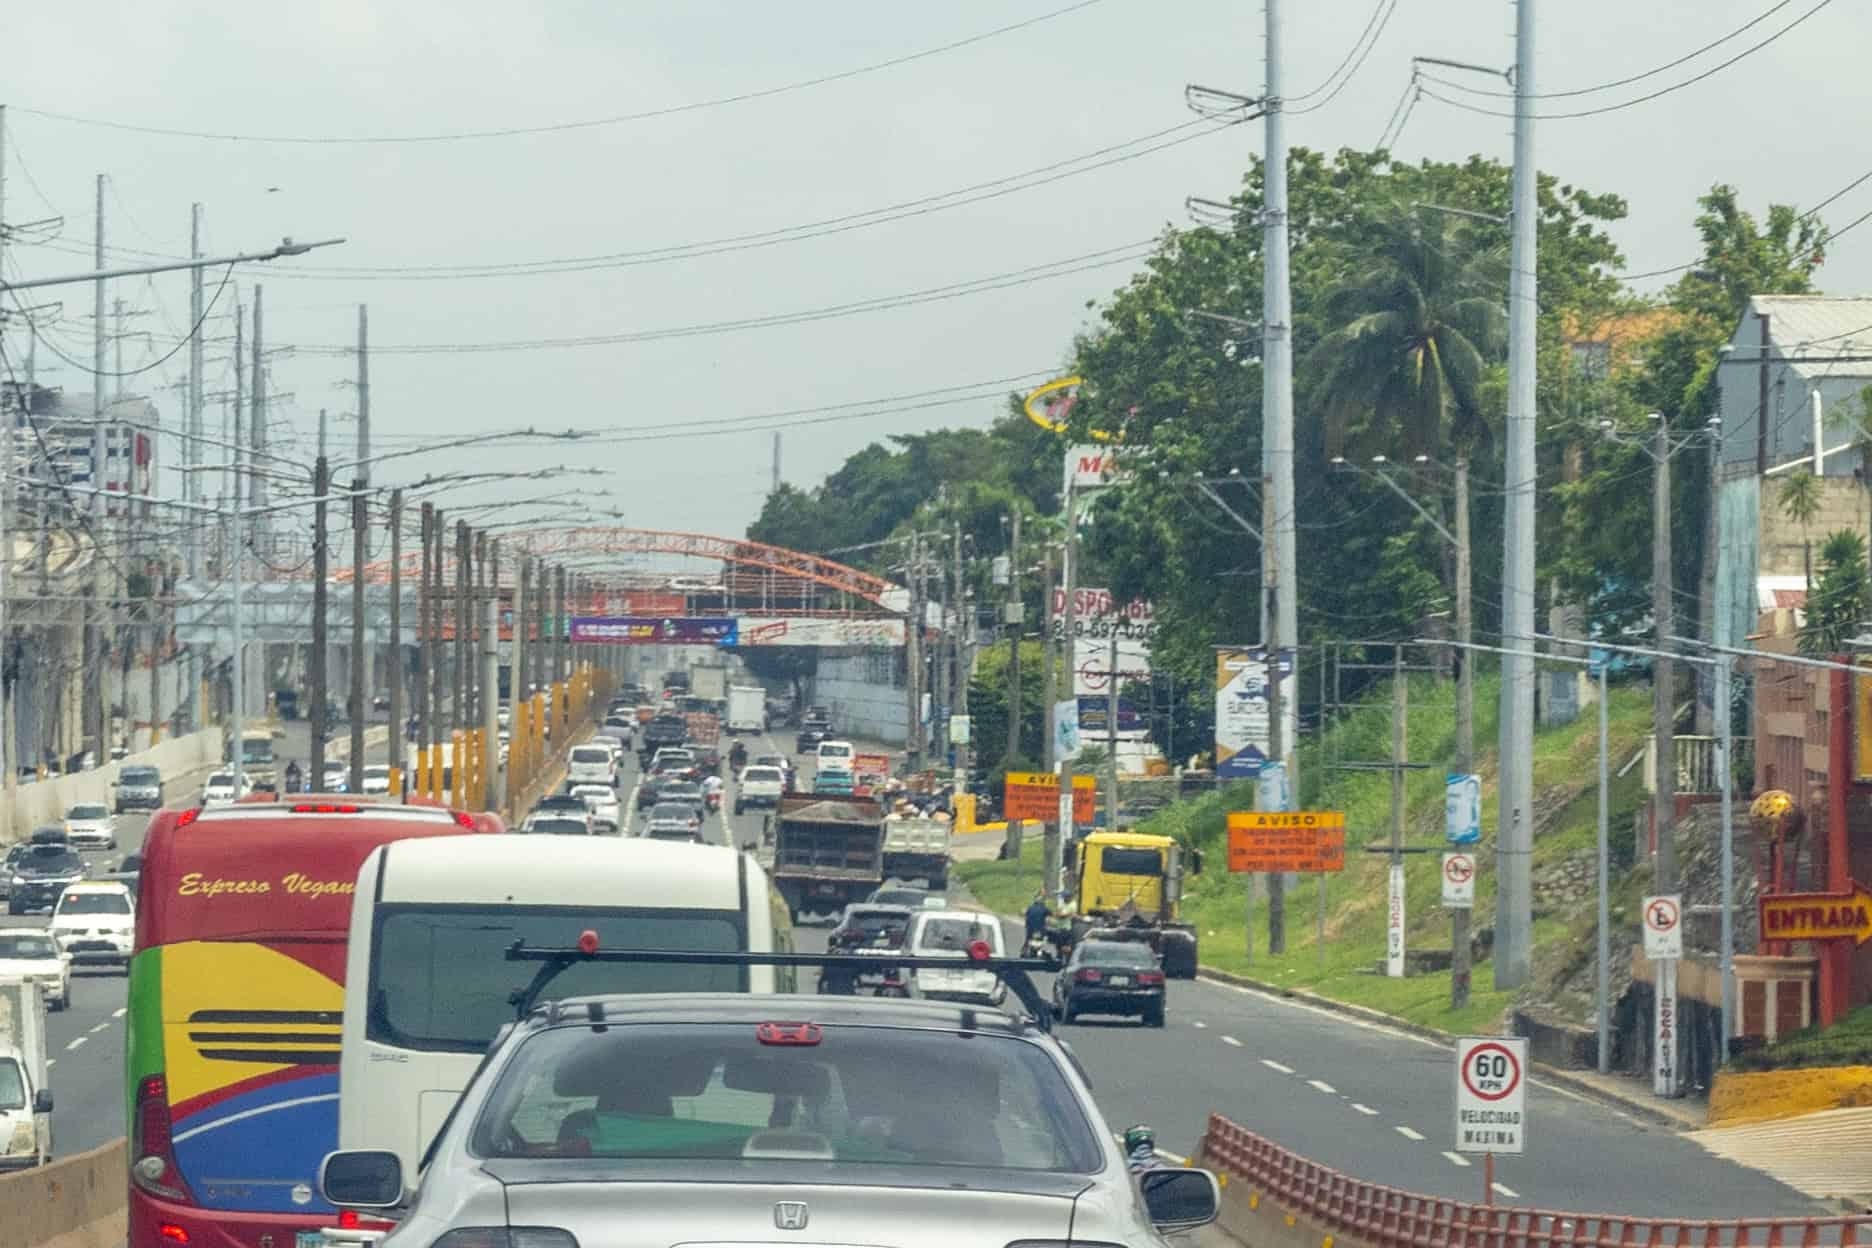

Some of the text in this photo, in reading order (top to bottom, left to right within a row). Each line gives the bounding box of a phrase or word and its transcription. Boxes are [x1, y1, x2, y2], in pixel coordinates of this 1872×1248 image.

[1256, 815, 1317, 825] AVISO
[178, 872, 271, 897] Expreso
[1766, 905, 1870, 931] ENTRADA
[1476, 1054, 1508, 1078] 60
[1461, 1109, 1520, 1124] VELOCIDAD
